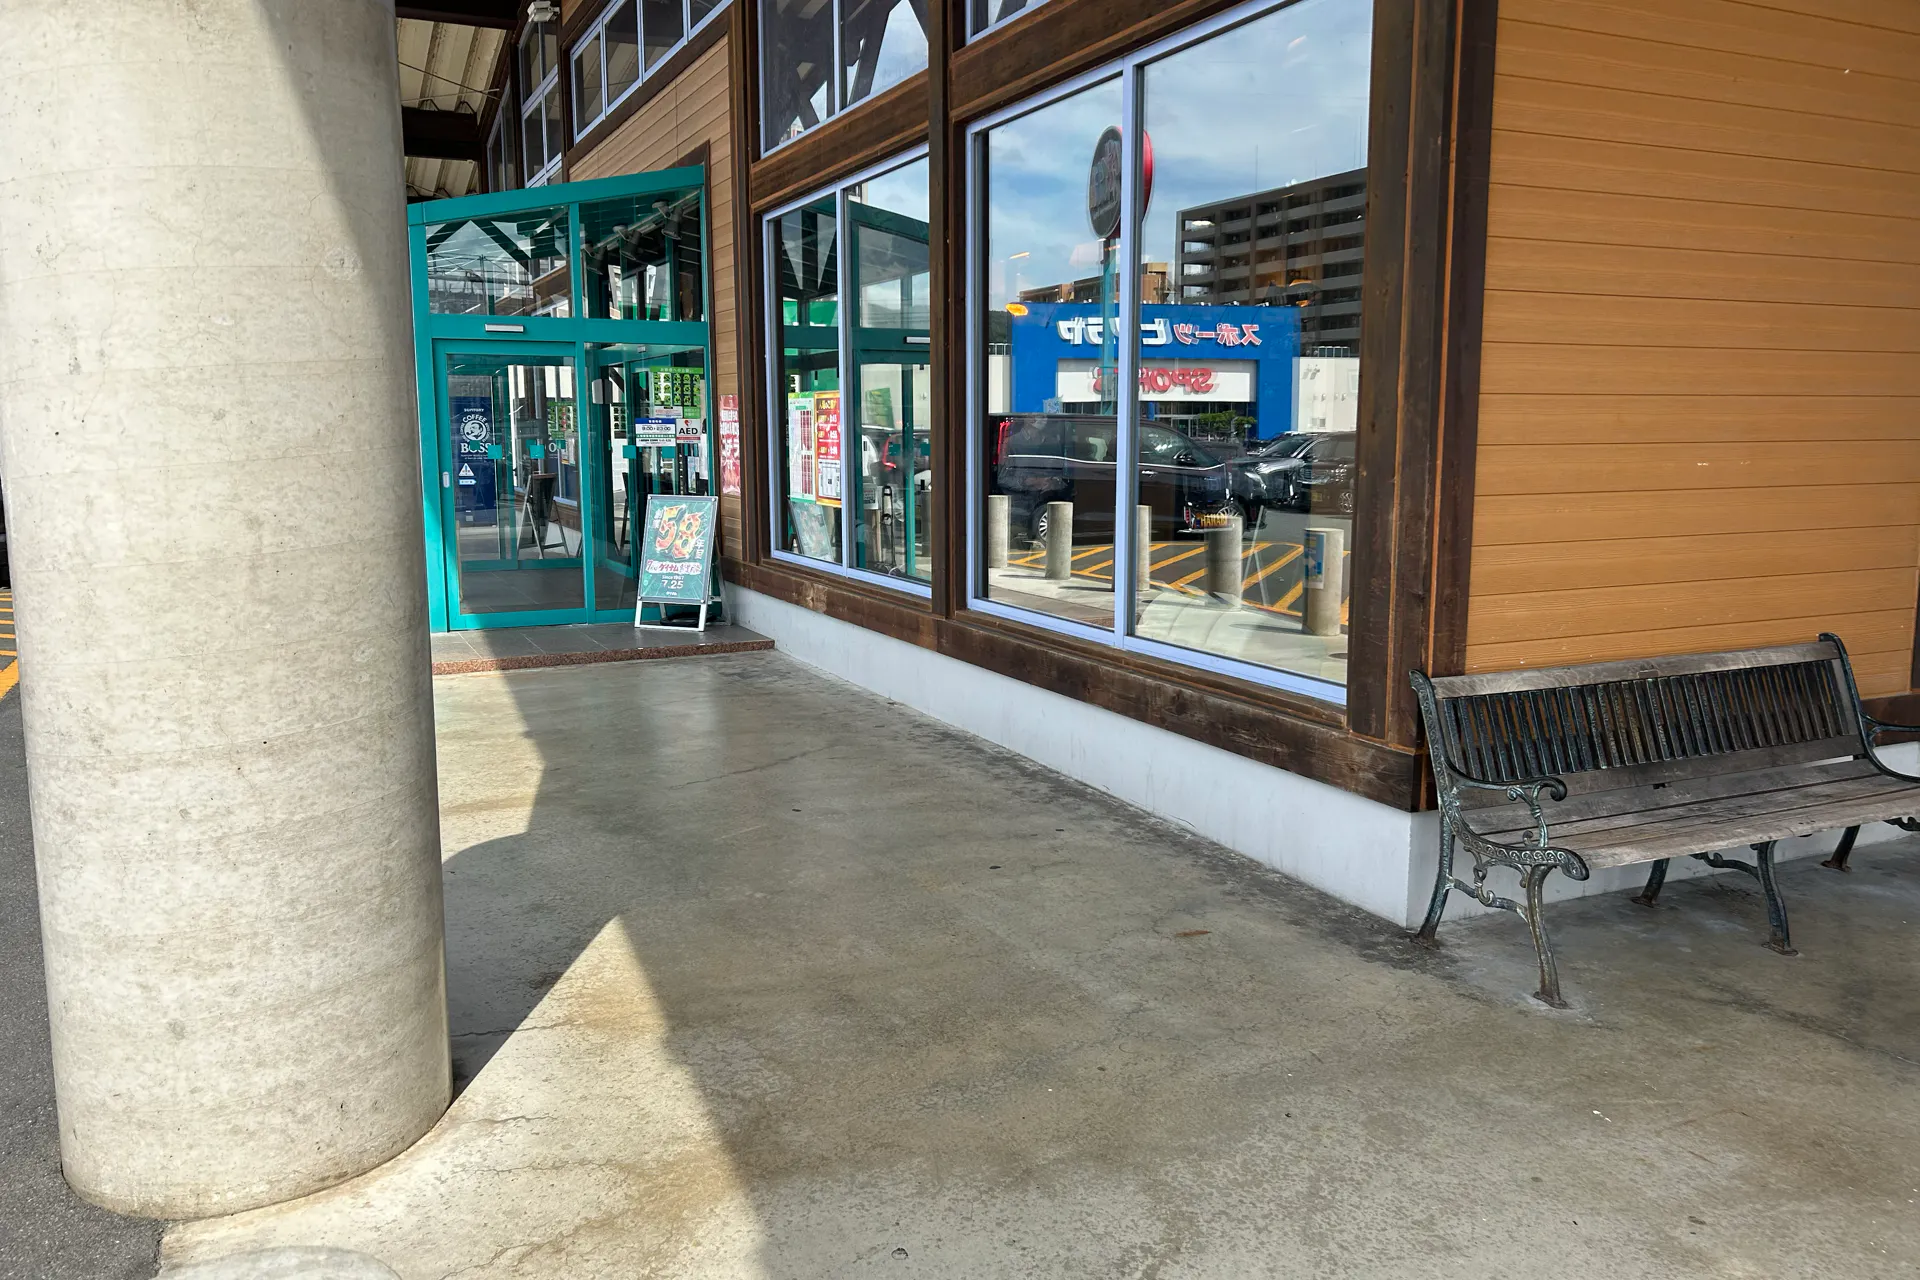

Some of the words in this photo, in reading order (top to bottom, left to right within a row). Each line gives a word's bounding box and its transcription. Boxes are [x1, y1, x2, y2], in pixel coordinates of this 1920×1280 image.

[462, 414, 487, 423] COFFEE
[656, 504, 704, 560] 58
[661, 580, 684, 590] 7.25
